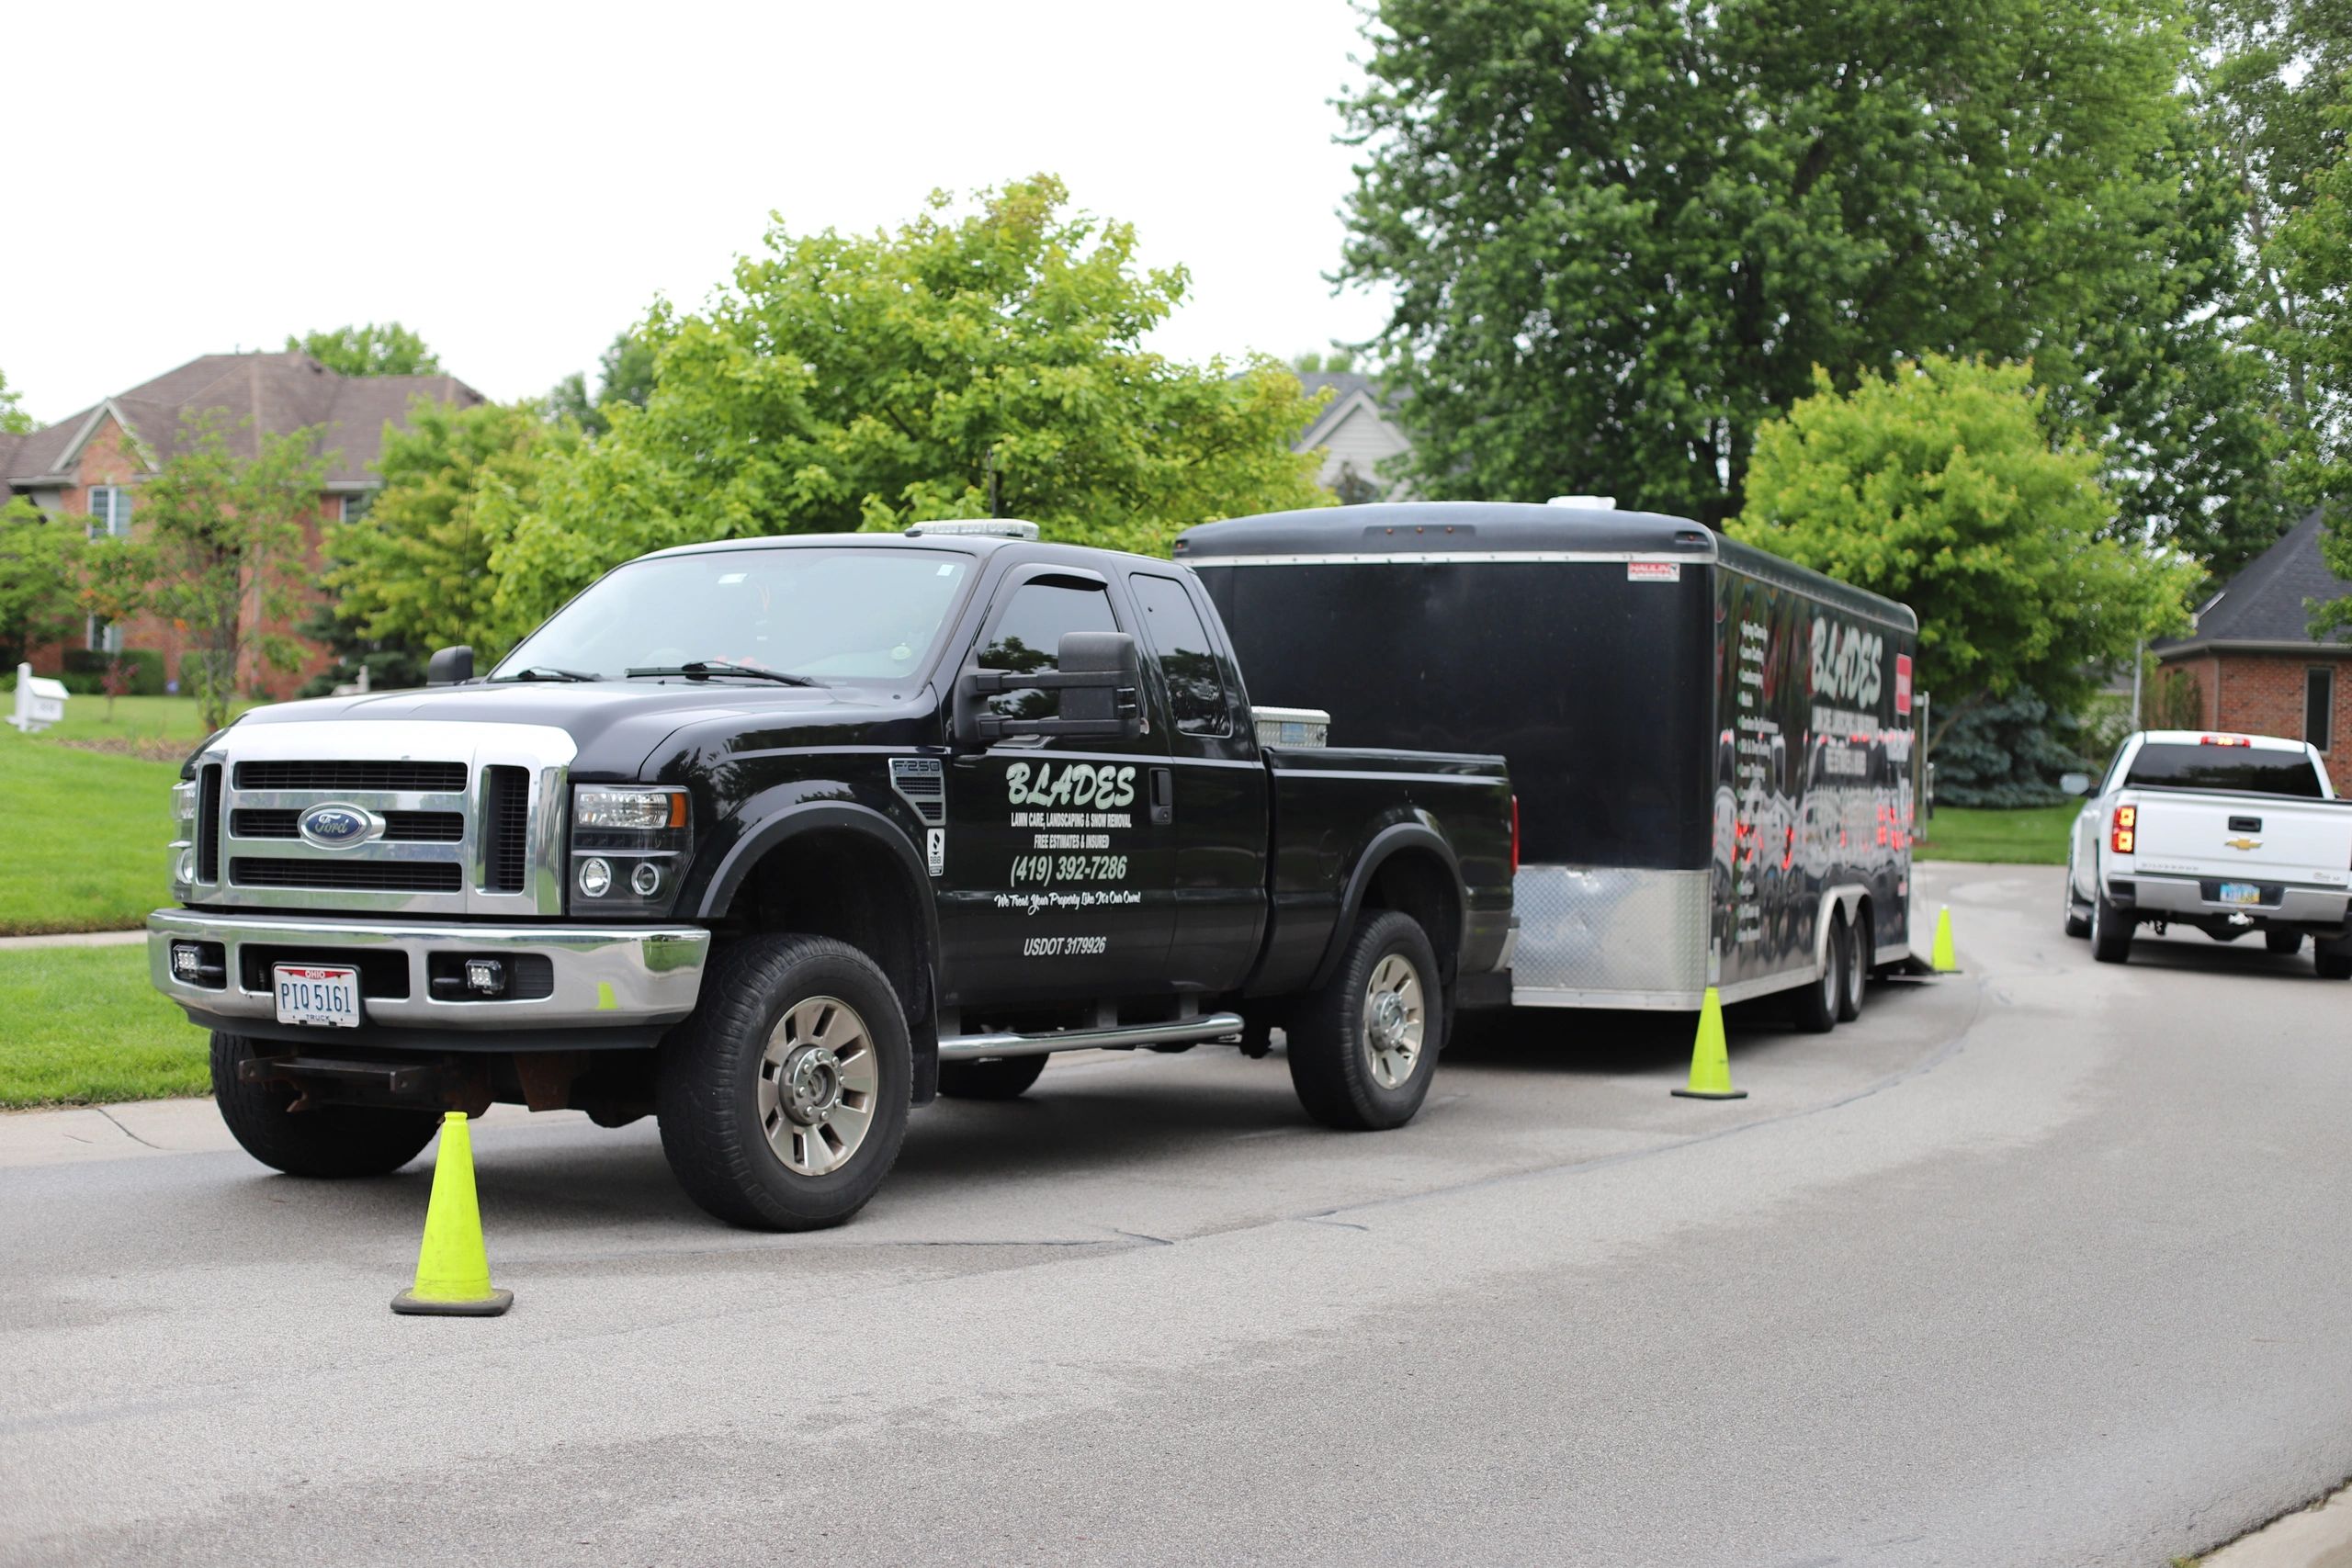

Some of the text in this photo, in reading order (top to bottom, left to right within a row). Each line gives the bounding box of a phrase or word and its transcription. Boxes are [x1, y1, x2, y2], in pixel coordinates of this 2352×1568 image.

[1811, 616, 1883, 709] BLADES
[893, 761, 941, 772] F-250
[1006, 761, 1136, 810] BLADES
[314, 814, 350, 834] Ford
[1011, 812, 1132, 830] LAWN CARE, LANDSCAPING & SNOW REMOVAL
[1034, 834, 1110, 849] FREE ESTIMATES & INSURED
[1011, 855, 1128, 887] (419) 392-7286
[993, 893, 1010, 908] We
[1027, 894, 1049, 916] Your
[1048, 892, 1080, 910] Property
[1080, 891, 1095, 906] Like
[1023, 936, 1107, 956] USDOT 3179926
[305, 970, 325, 979] OHIO
[314, 985, 351, 1013] 5161
